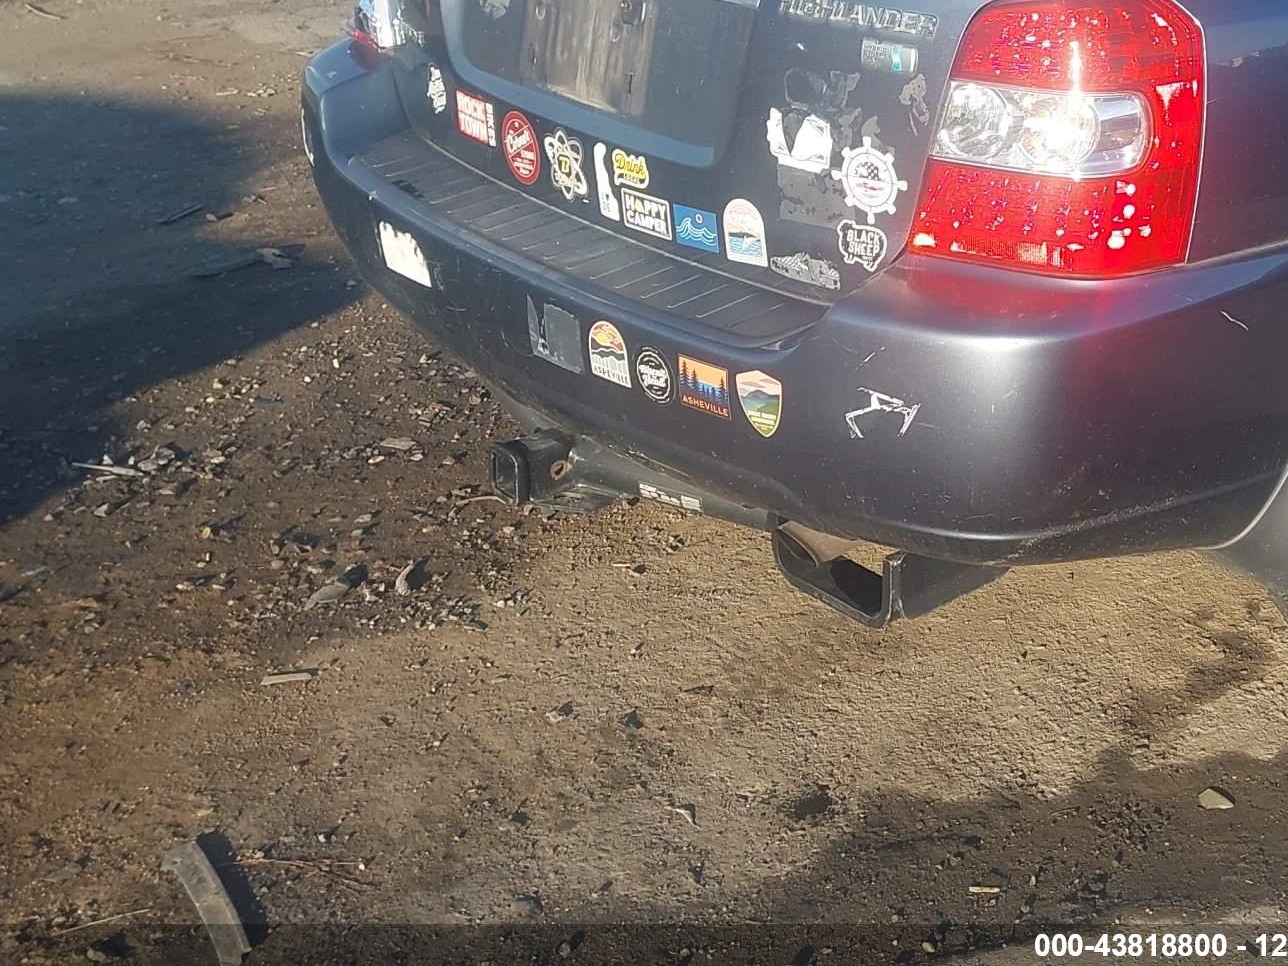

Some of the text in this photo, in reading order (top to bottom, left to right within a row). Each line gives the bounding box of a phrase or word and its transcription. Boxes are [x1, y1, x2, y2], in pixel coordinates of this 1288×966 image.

[456, 90, 486, 124] ROCK
[458, 110, 489, 144] TOWN
[615, 153, 646, 176] Drink
[625, 194, 667, 221] HAPPY
[626, 209, 668, 236] CAMPER
[846, 229, 880, 246] BLACK
[848, 240, 880, 256] SHEEP
[593, 365, 629, 386] ASHEVILLE
[682, 394, 729, 417] ASHEVILLE
